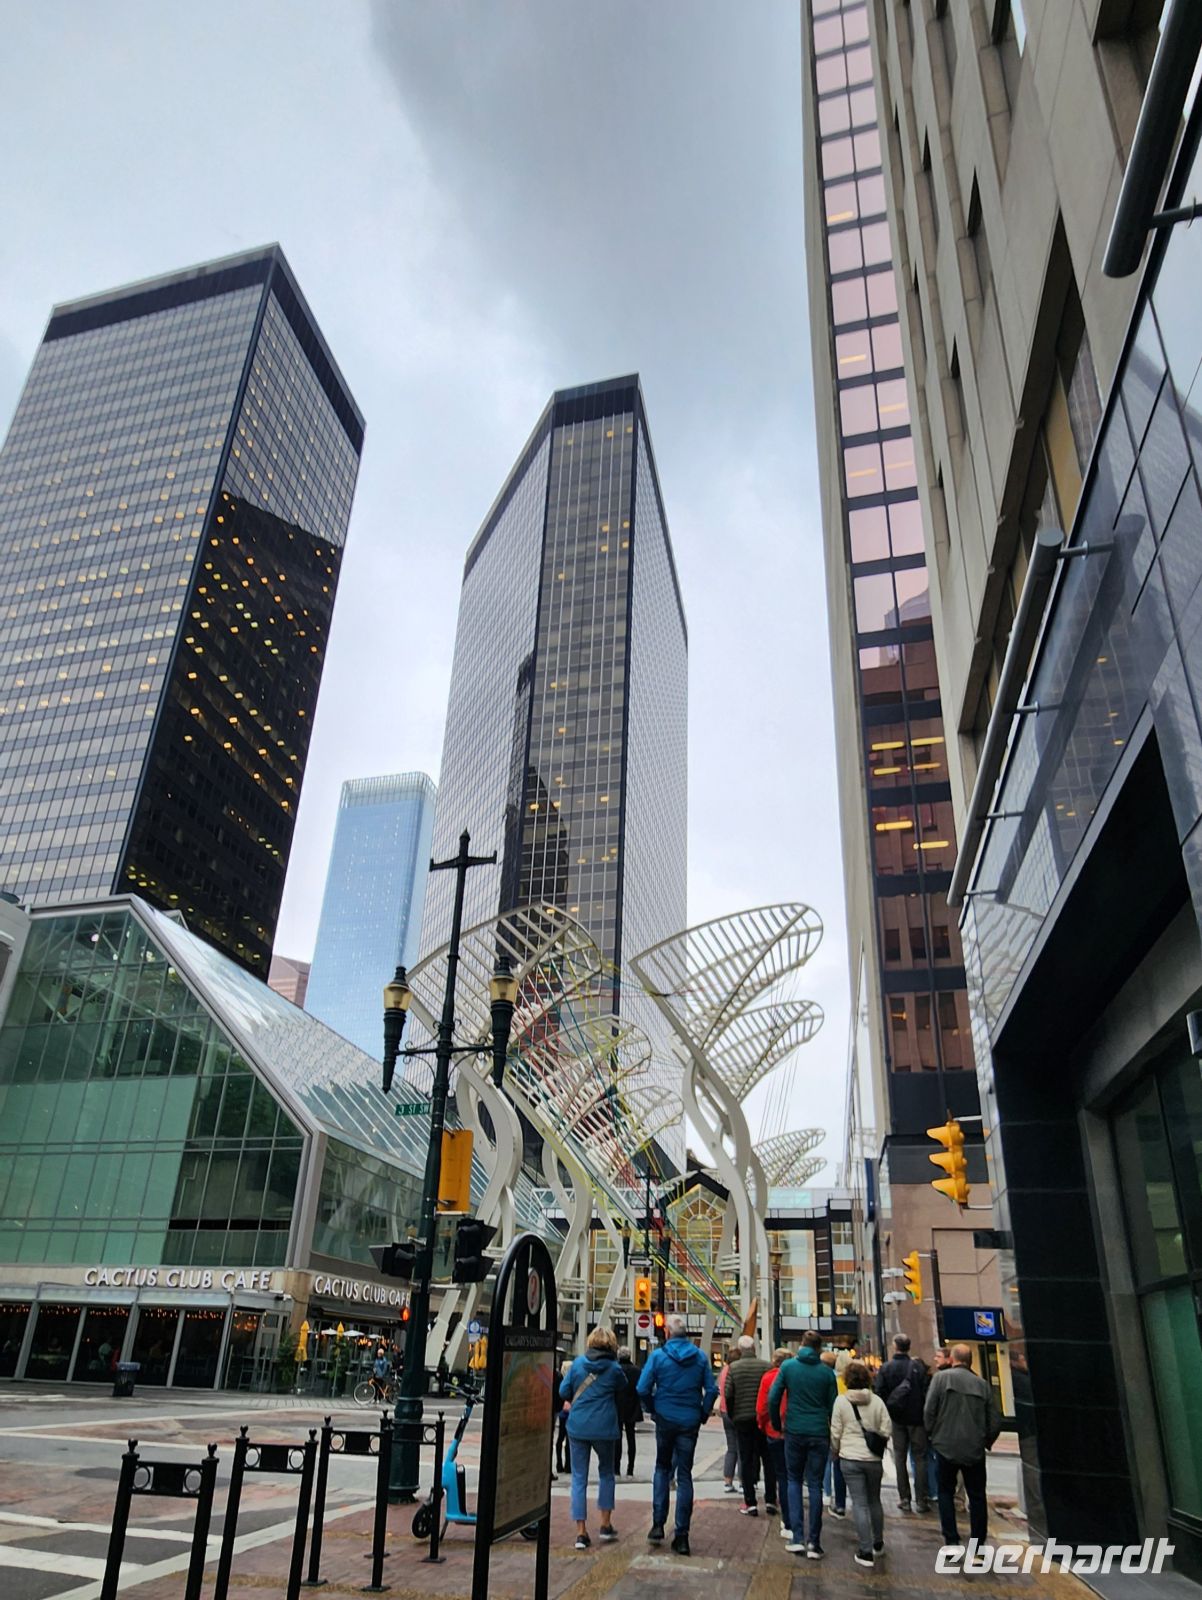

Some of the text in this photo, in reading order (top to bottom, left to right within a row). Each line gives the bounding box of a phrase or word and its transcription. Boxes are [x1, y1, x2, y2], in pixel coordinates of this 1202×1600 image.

[398, 1104, 429, 1114] 3 ST SW
[84, 1267, 272, 1290] CACTUS CLUB CAFE
[314, 1275, 410, 1307] CACTUS CLUB CAFE
